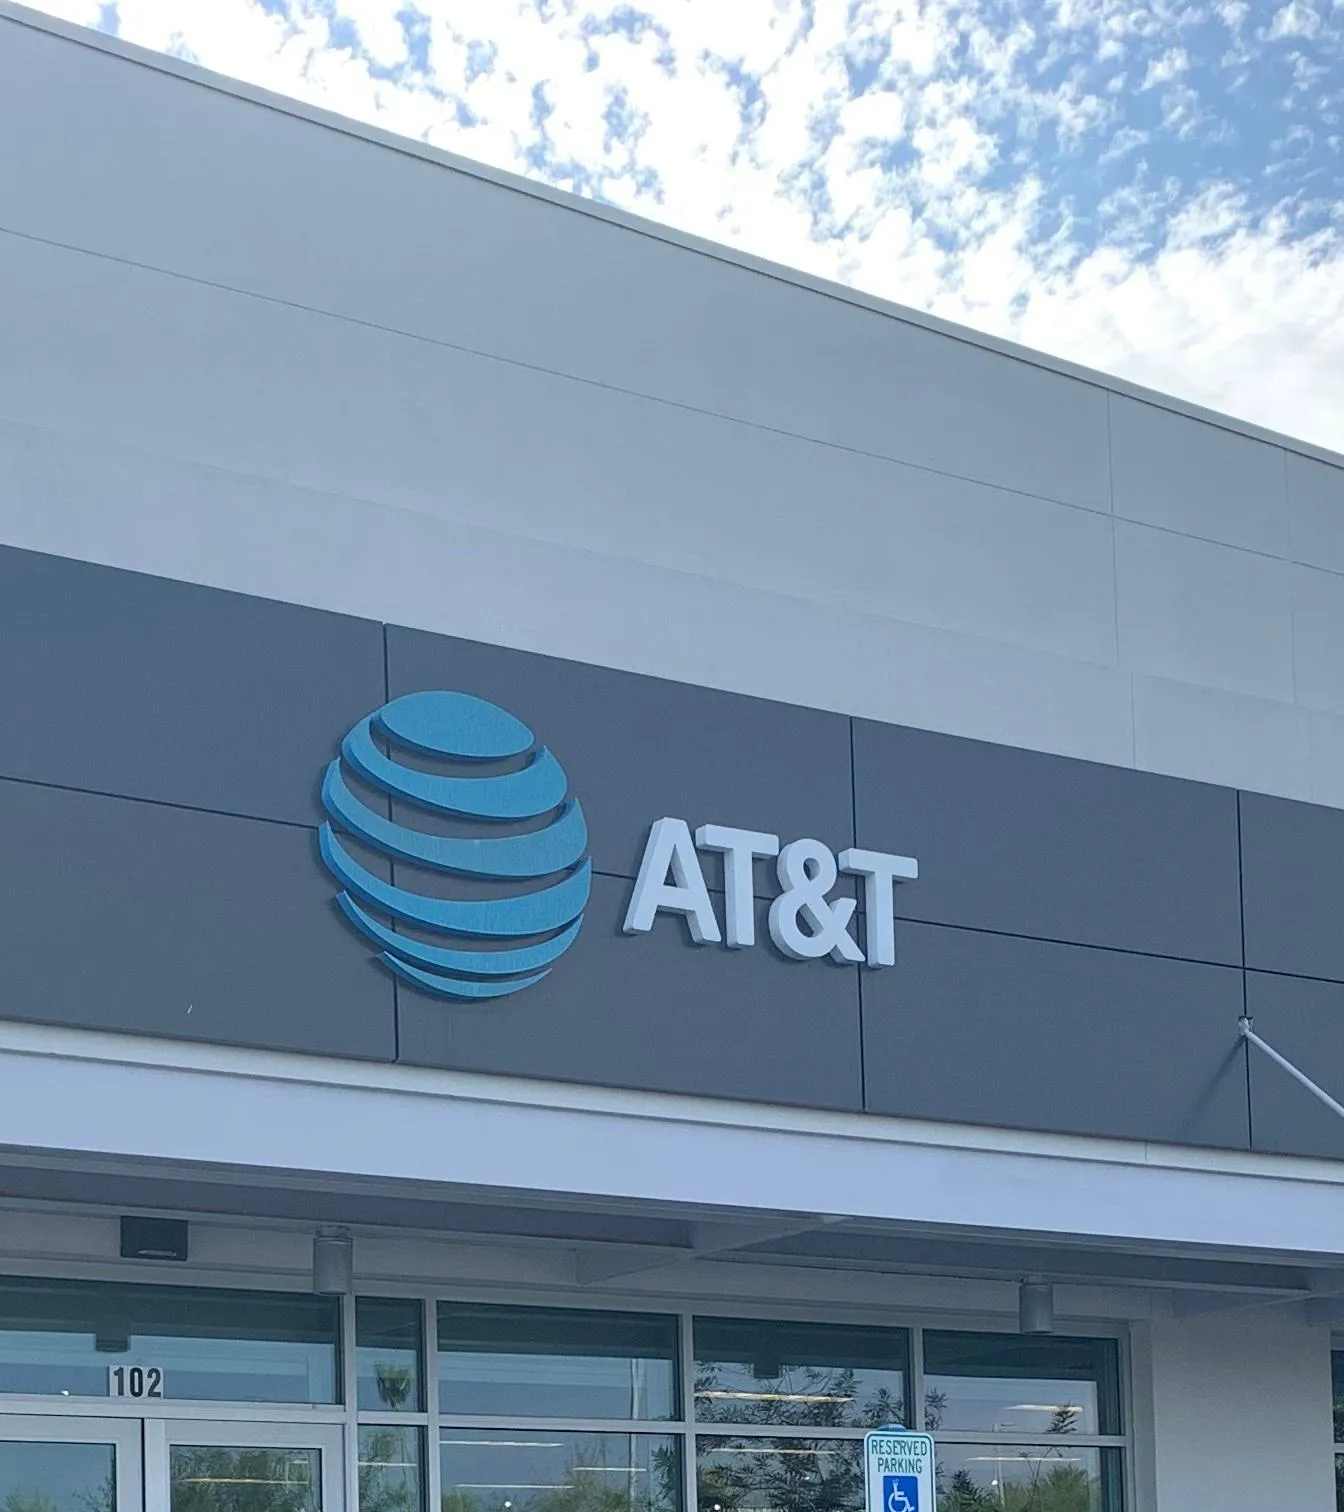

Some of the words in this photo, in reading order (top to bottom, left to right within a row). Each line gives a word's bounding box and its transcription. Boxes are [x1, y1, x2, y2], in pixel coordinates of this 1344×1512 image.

[622, 817, 918, 969] AT&T
[114, 1366, 162, 1398] 102
[871, 1439, 928, 1456] RESERVED
[877, 1457, 923, 1474] PARKING
